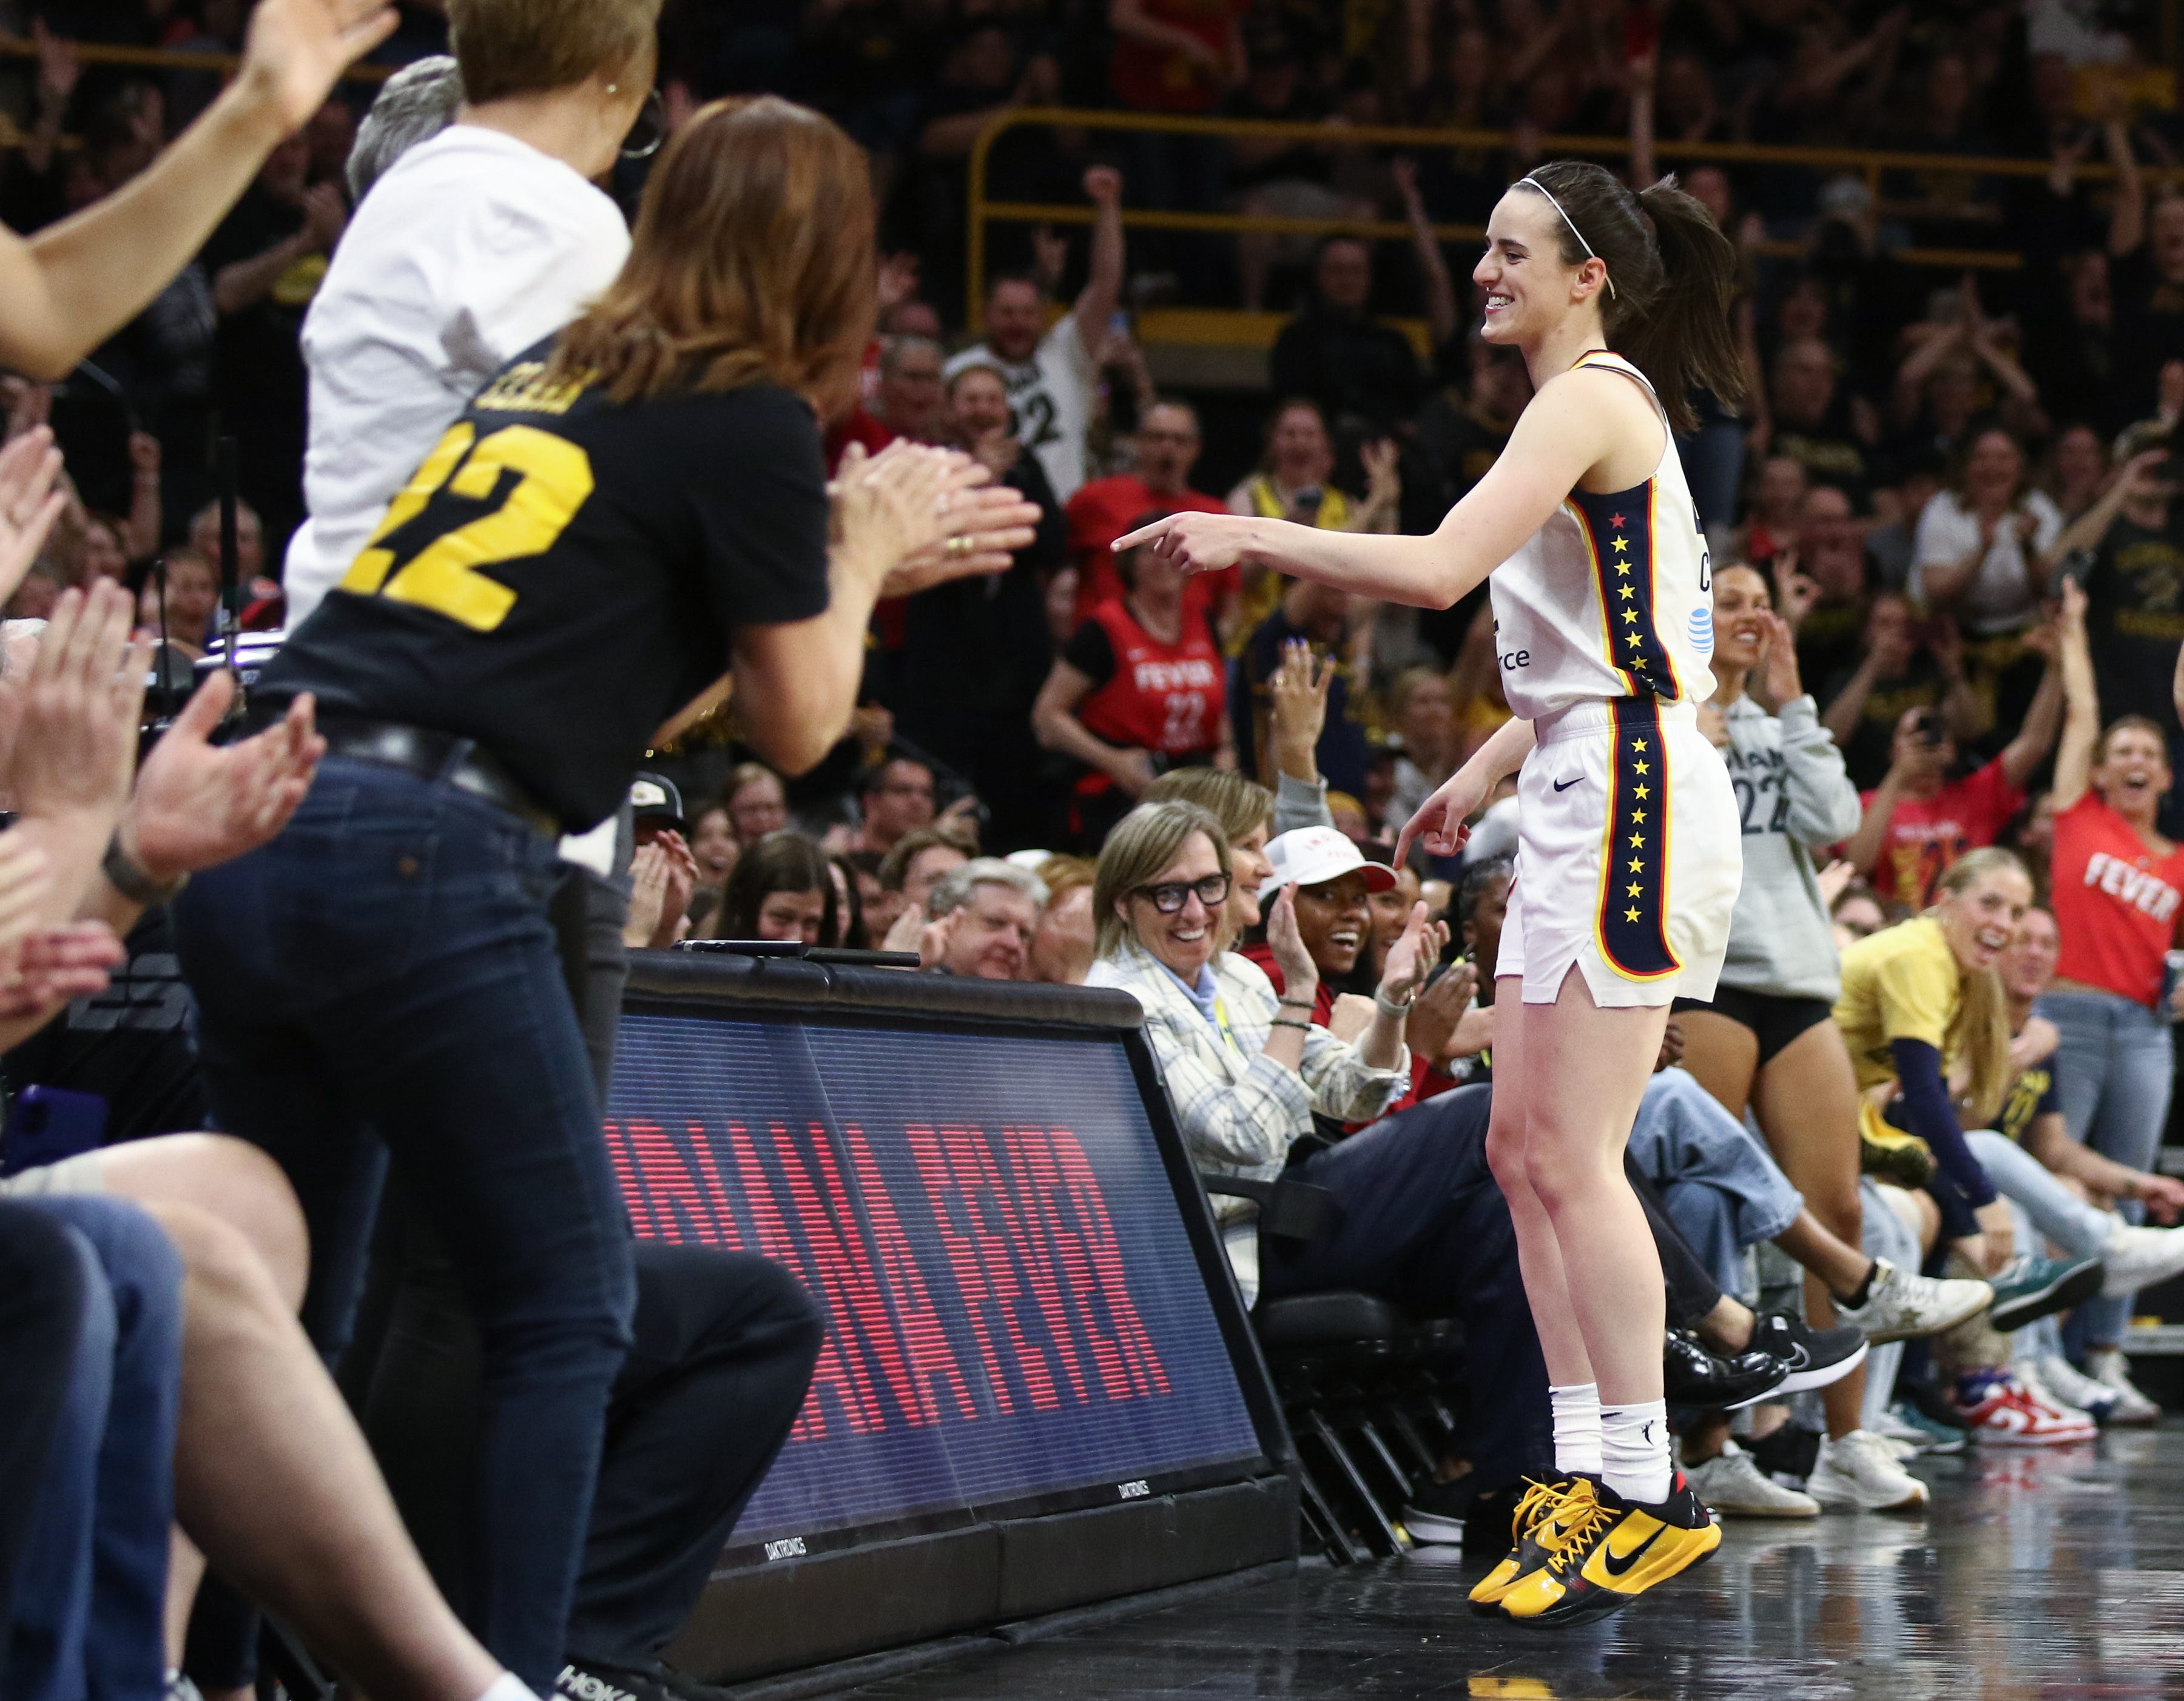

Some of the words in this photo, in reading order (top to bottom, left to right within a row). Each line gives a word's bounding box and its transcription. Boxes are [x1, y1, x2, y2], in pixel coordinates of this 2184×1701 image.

[337, 421, 596, 632] 22
[1732, 775, 1789, 835] 22
[2083, 852, 2182, 925] FEVER
[903, 1123, 1173, 1416] FEVER
[764, 1536, 807, 1561] DAKTRONICS
[555, 1664, 637, 1701] HOK
